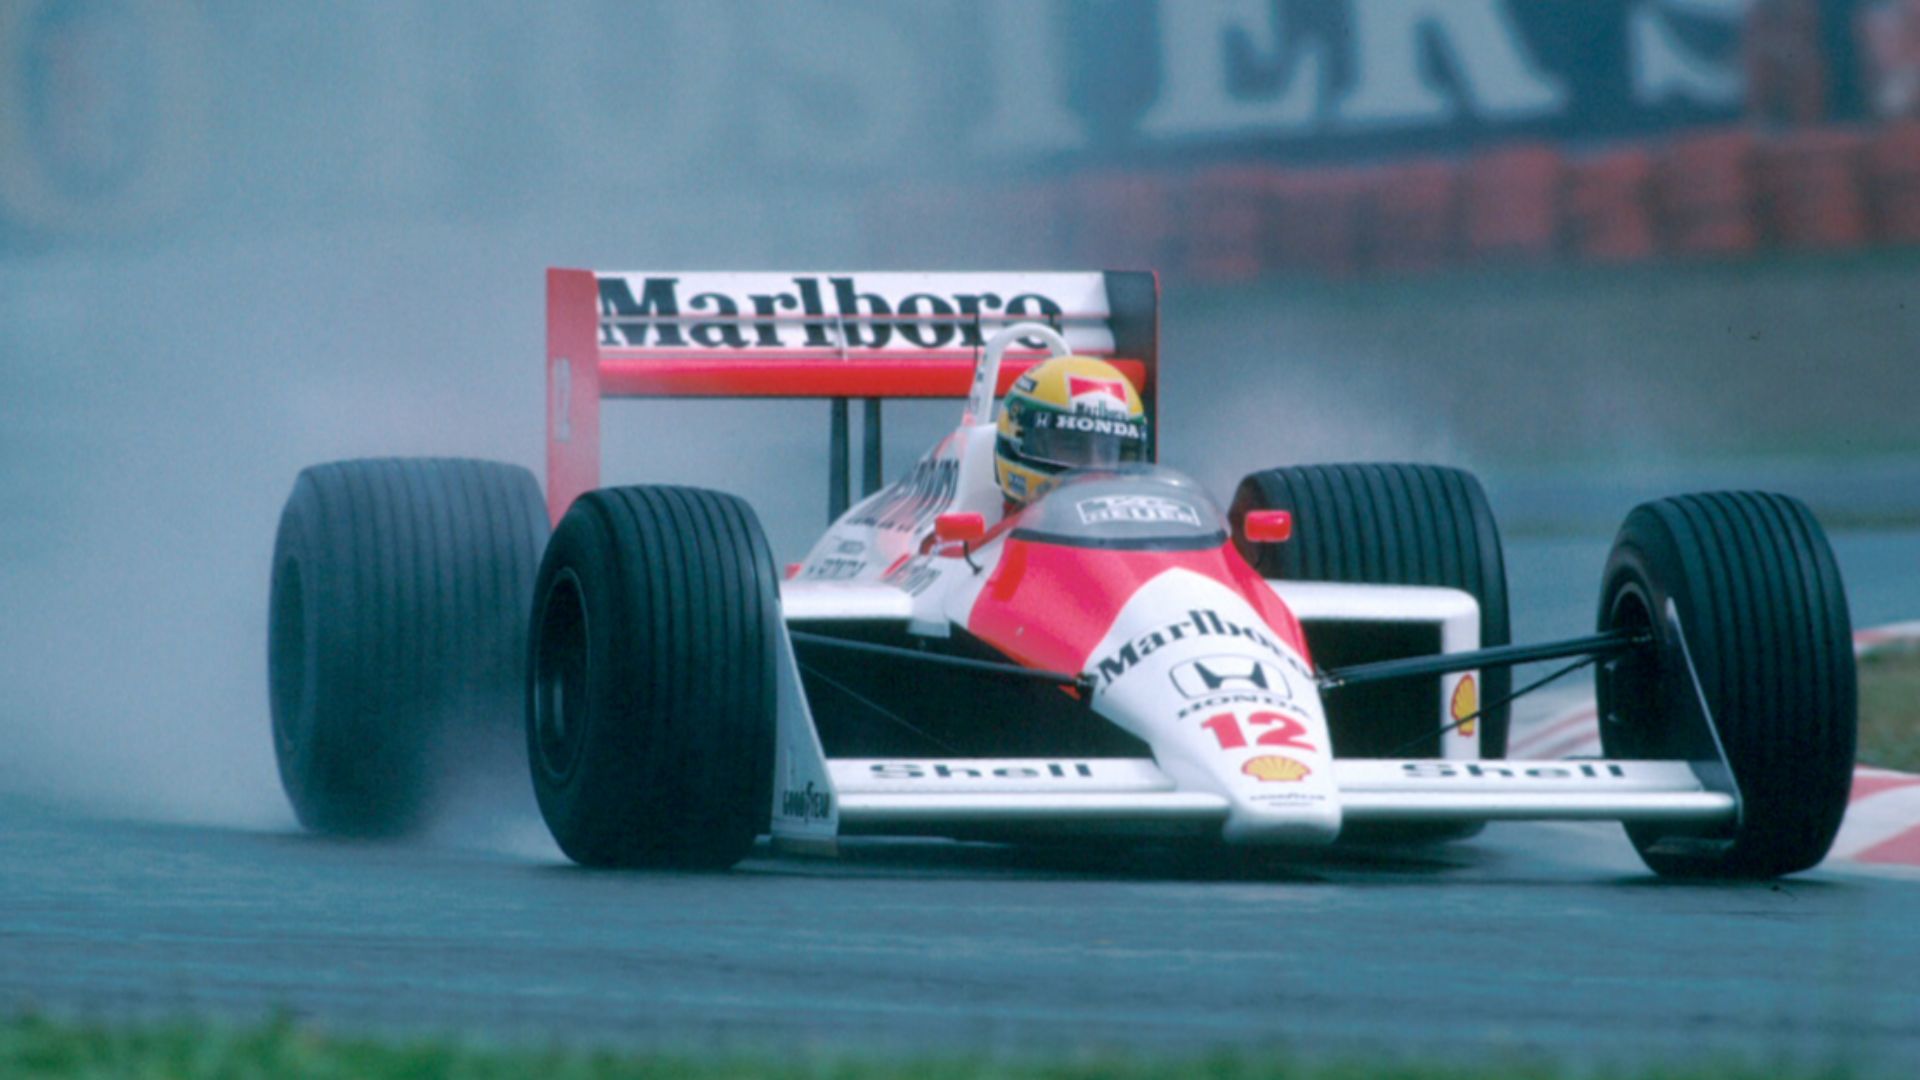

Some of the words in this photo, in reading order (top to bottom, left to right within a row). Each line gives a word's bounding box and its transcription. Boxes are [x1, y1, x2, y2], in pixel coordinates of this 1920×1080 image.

[597, 276, 1064, 349] Marlboro
[1056, 415, 1139, 438] HONDA
[1200, 711, 1317, 751] 12
[869, 763, 1093, 778] Shell
[1402, 763, 1626, 778] Shell
